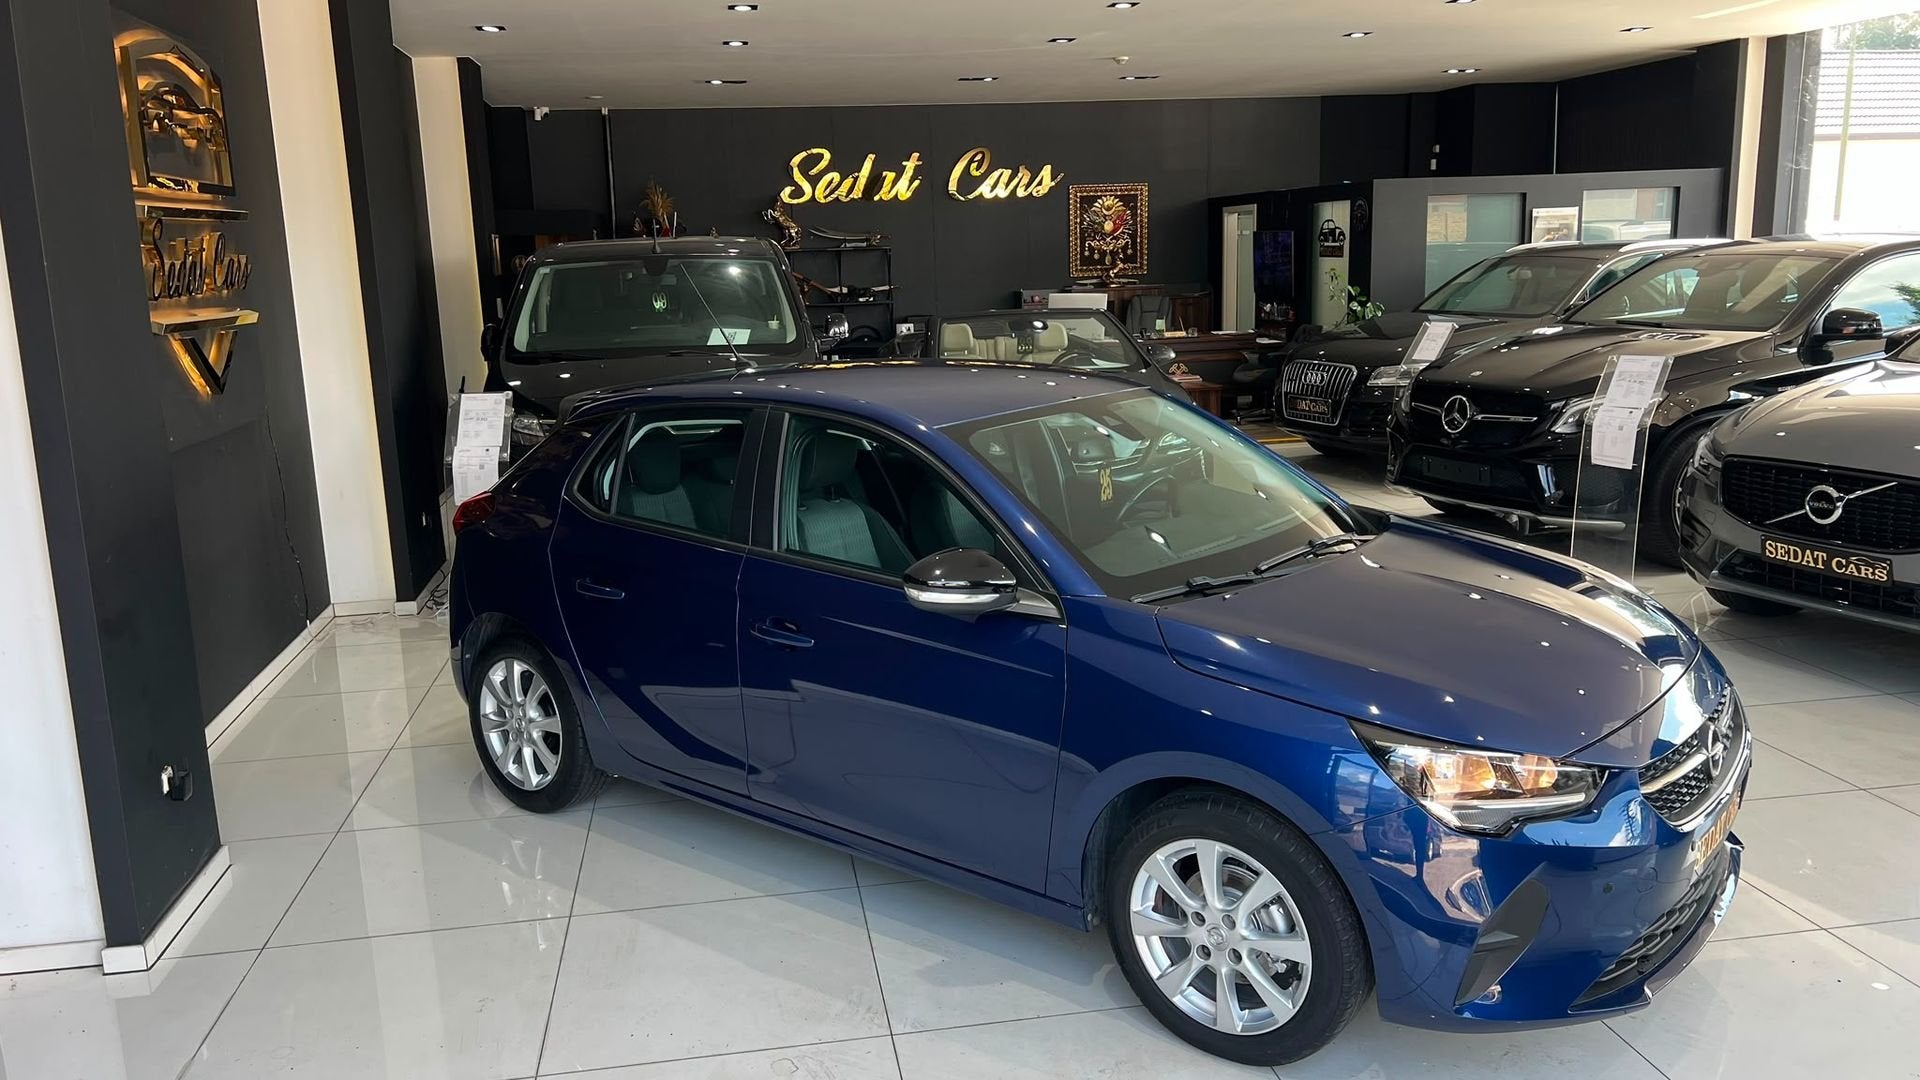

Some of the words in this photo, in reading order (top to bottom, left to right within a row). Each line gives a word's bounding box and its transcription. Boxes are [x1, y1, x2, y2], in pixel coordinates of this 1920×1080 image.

[779, 147, 923, 204] Sedat
[948, 147, 1065, 201] Cars
[212, 232, 251, 290] Cars
[1765, 540, 1827, 570] SEDAT
[1831, 557, 1888, 582] CARS
